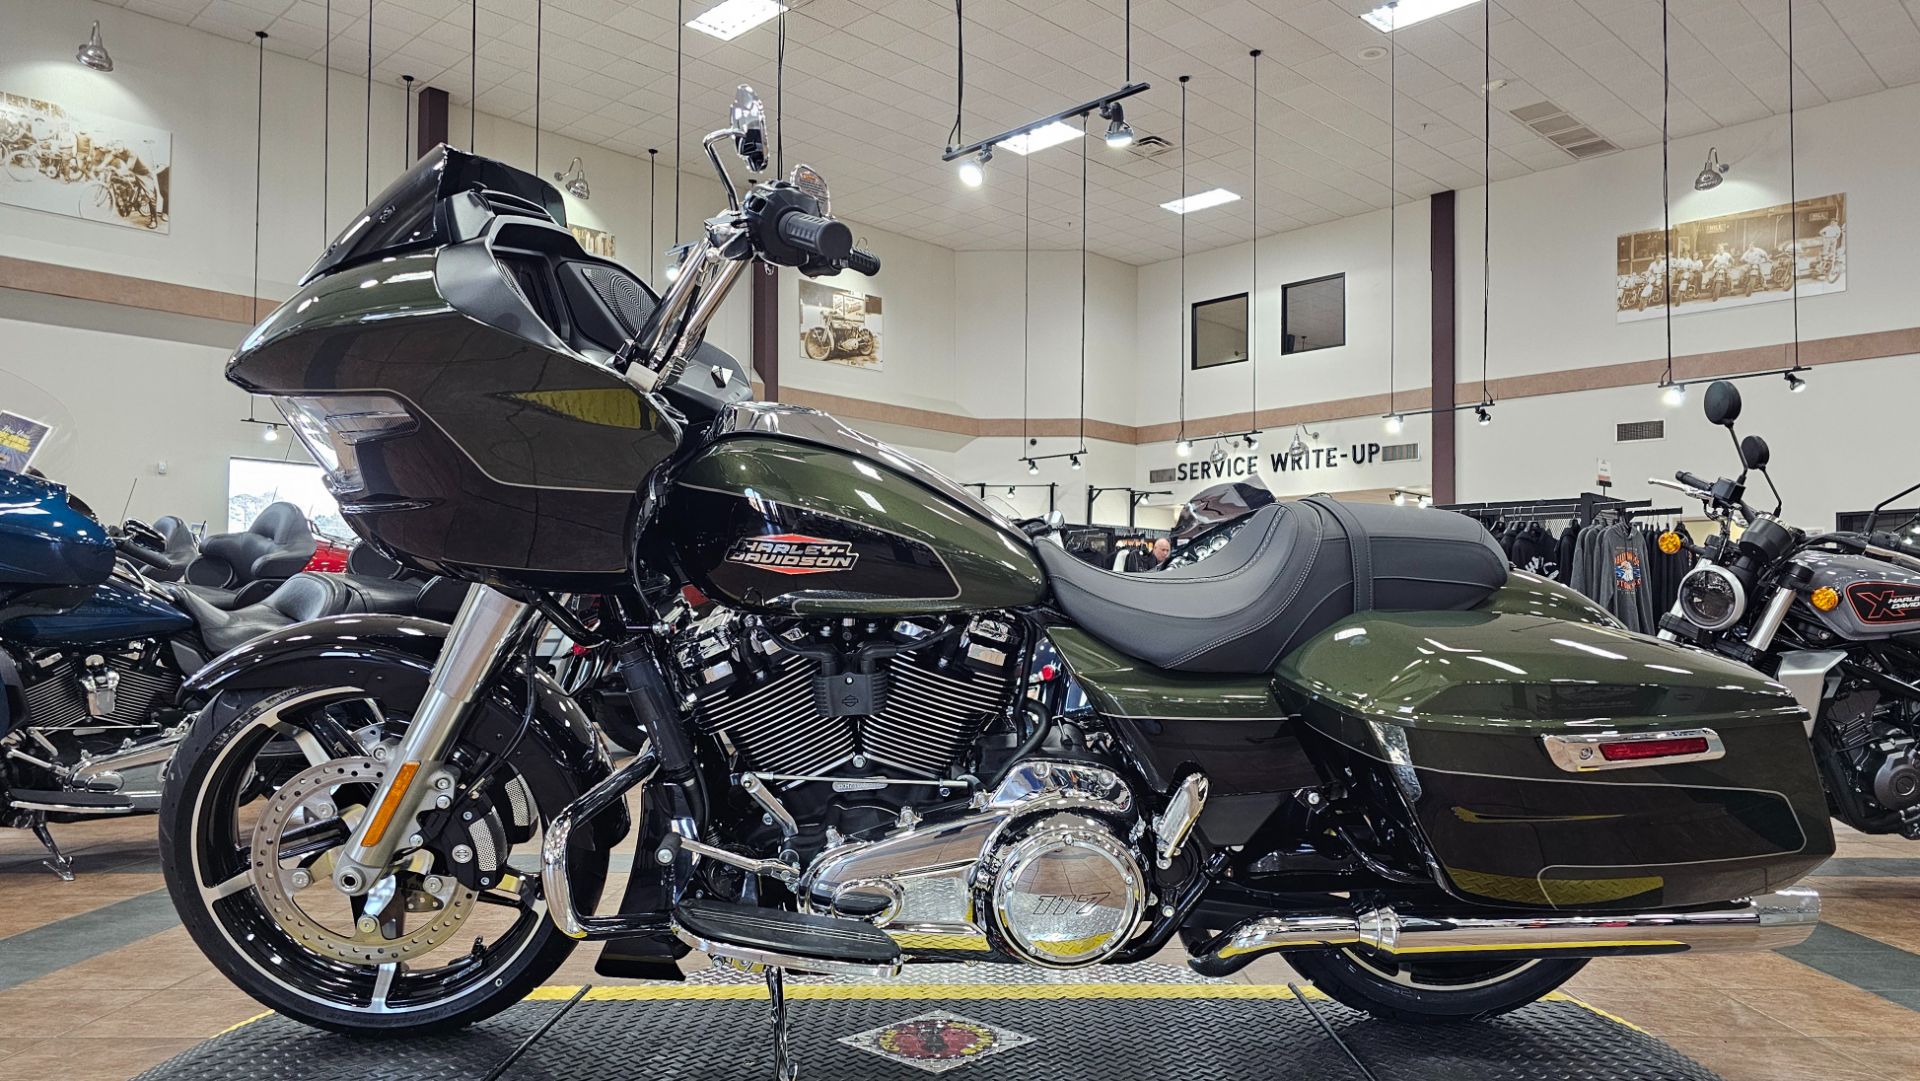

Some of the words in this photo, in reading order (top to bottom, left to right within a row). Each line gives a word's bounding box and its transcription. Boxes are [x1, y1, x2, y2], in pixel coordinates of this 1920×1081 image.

[1177, 455, 1258, 481] SERVICE
[1270, 442, 1380, 473] WRITE-UP
[740, 540, 845, 555] HARLEY-
[729, 553, 853, 568] DAVIDSON
[1032, 890, 1112, 915] 117
